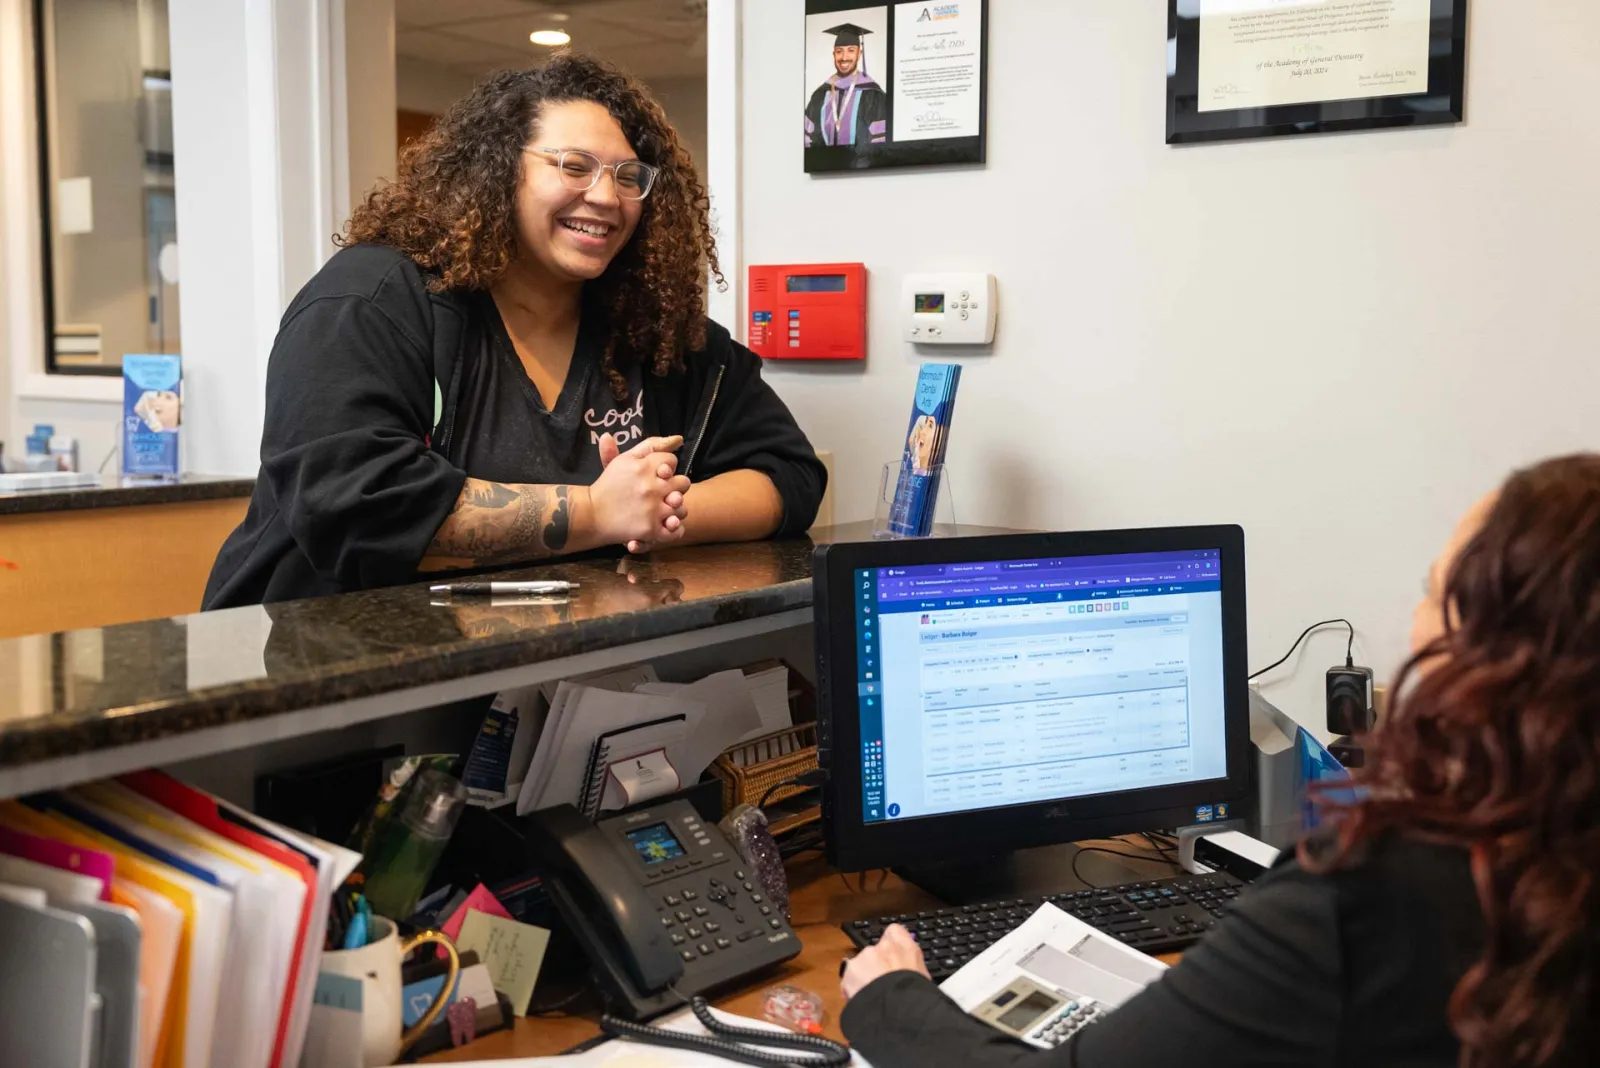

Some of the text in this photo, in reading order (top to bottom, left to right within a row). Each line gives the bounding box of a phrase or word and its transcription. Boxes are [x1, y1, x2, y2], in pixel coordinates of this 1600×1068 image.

[1263, 60, 1273, 68] the
[1274, 58, 1301, 68] Academy
[1310, 55, 1333, 64] General
[1333, 52, 1364, 62] Dentistry
[1290, 68, 1303, 79] July
[941, 630, 961, 639] Barbara
